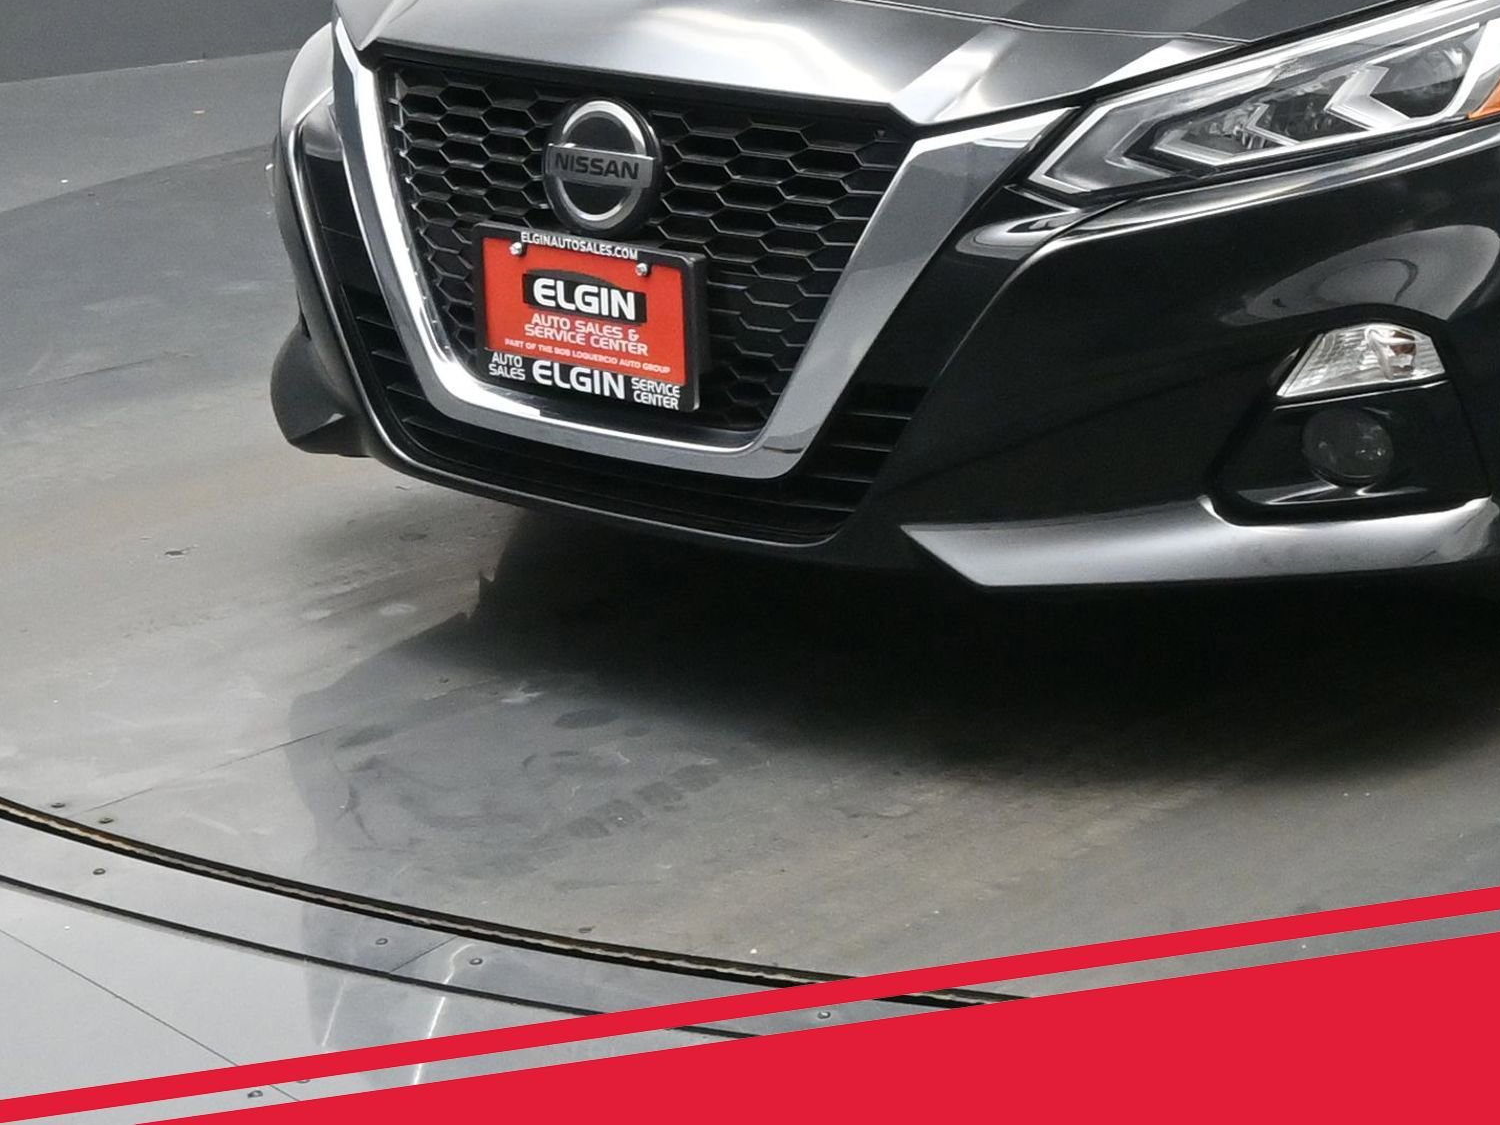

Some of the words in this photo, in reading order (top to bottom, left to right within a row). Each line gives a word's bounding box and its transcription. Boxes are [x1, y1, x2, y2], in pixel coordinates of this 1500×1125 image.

[554, 151, 639, 180] NISSAN
[520, 231, 638, 261] ELGINAUTOSALES.COM
[533, 277, 636, 321] ELGIN
[524, 323, 586, 346] SERVICE
[589, 335, 649, 356] CENTER
[531, 313, 571, 331] AUTO
[574, 320, 624, 340] SALES
[627, 328, 640, 342] &
[491, 351, 523, 368] AUTO
[504, 338, 525, 349] PART
[525, 341, 537, 350] OF
[619, 358, 641, 369] AUTO
[488, 363, 527, 382] SALES
[532, 359, 625, 400] ELGIN
[630, 377, 681, 399] SERVICE
[633, 390, 680, 411] CENTER
